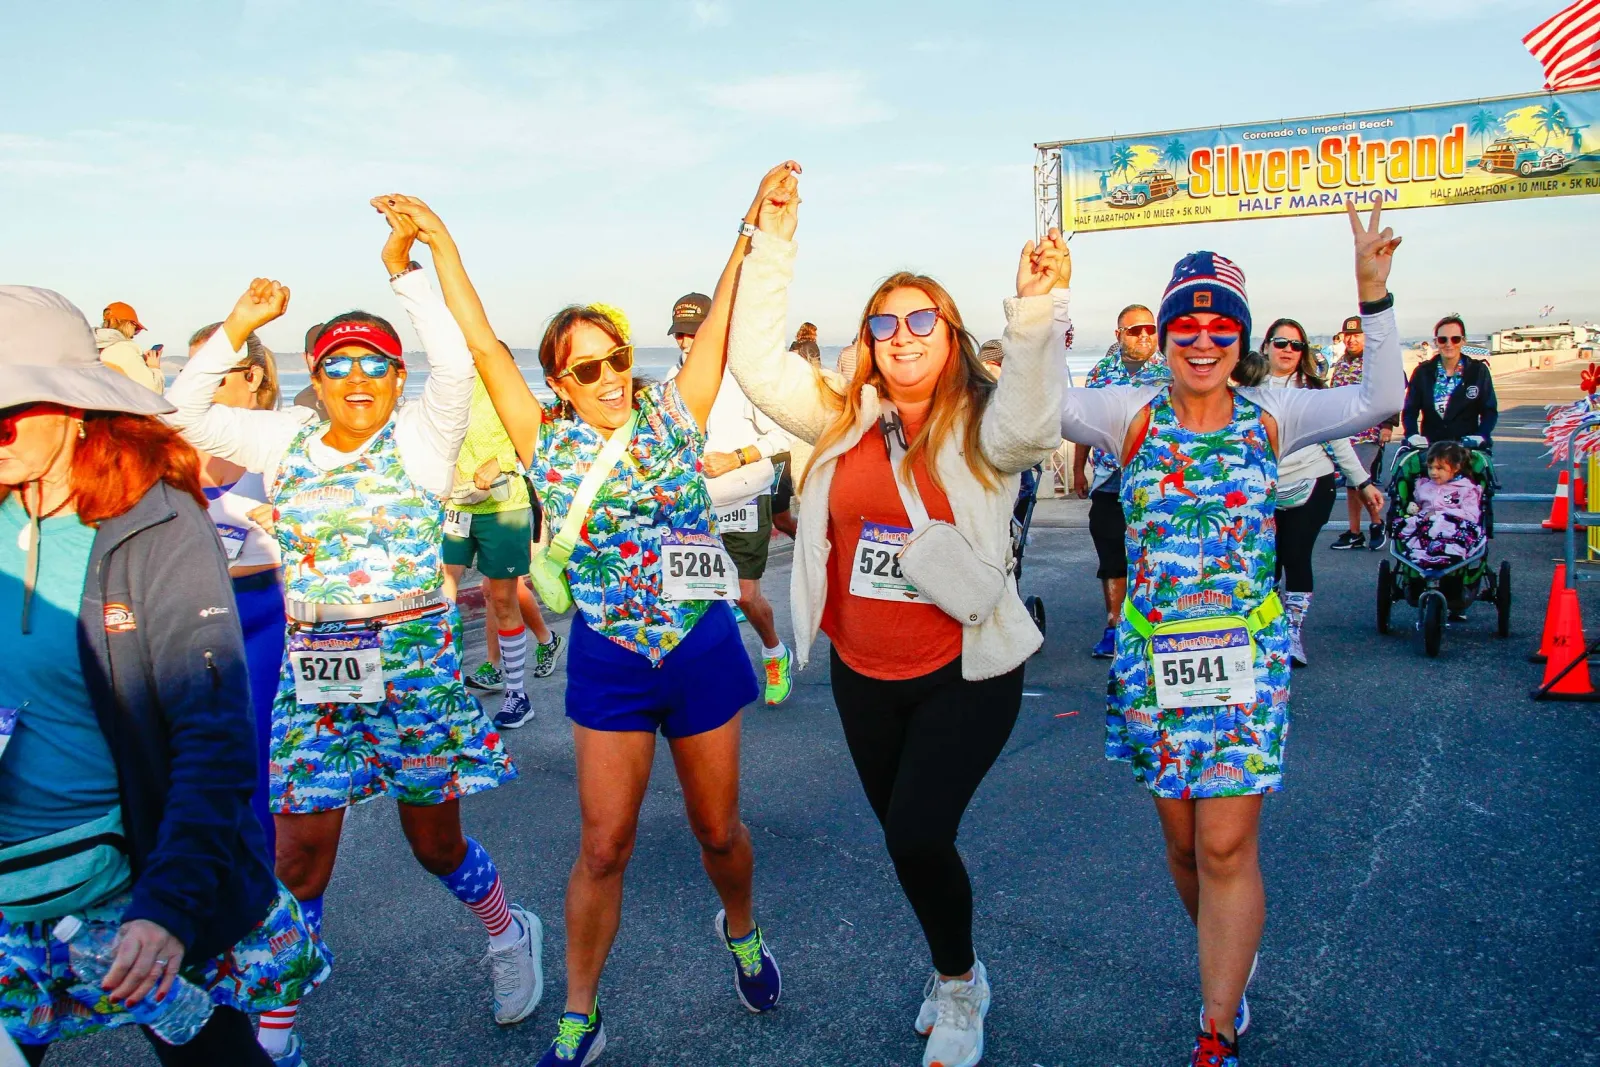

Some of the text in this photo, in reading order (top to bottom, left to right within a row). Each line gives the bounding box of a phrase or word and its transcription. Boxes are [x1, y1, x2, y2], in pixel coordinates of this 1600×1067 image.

[1242, 118, 1394, 140] Coronado to Imperial Beach
[1188, 123, 1467, 199] Silver Strand
[1239, 188, 1398, 212] HALF MARATHON
[1430, 177, 1600, 199] HALF MARATHON 10 MILER 5K RU
[1074, 205, 1212, 225] HALF MARATHON 10 MILER 5K RUN
[669, 551, 726, 578] 5284
[299, 657, 361, 681] 5270
[1162, 655, 1229, 686] 5541
